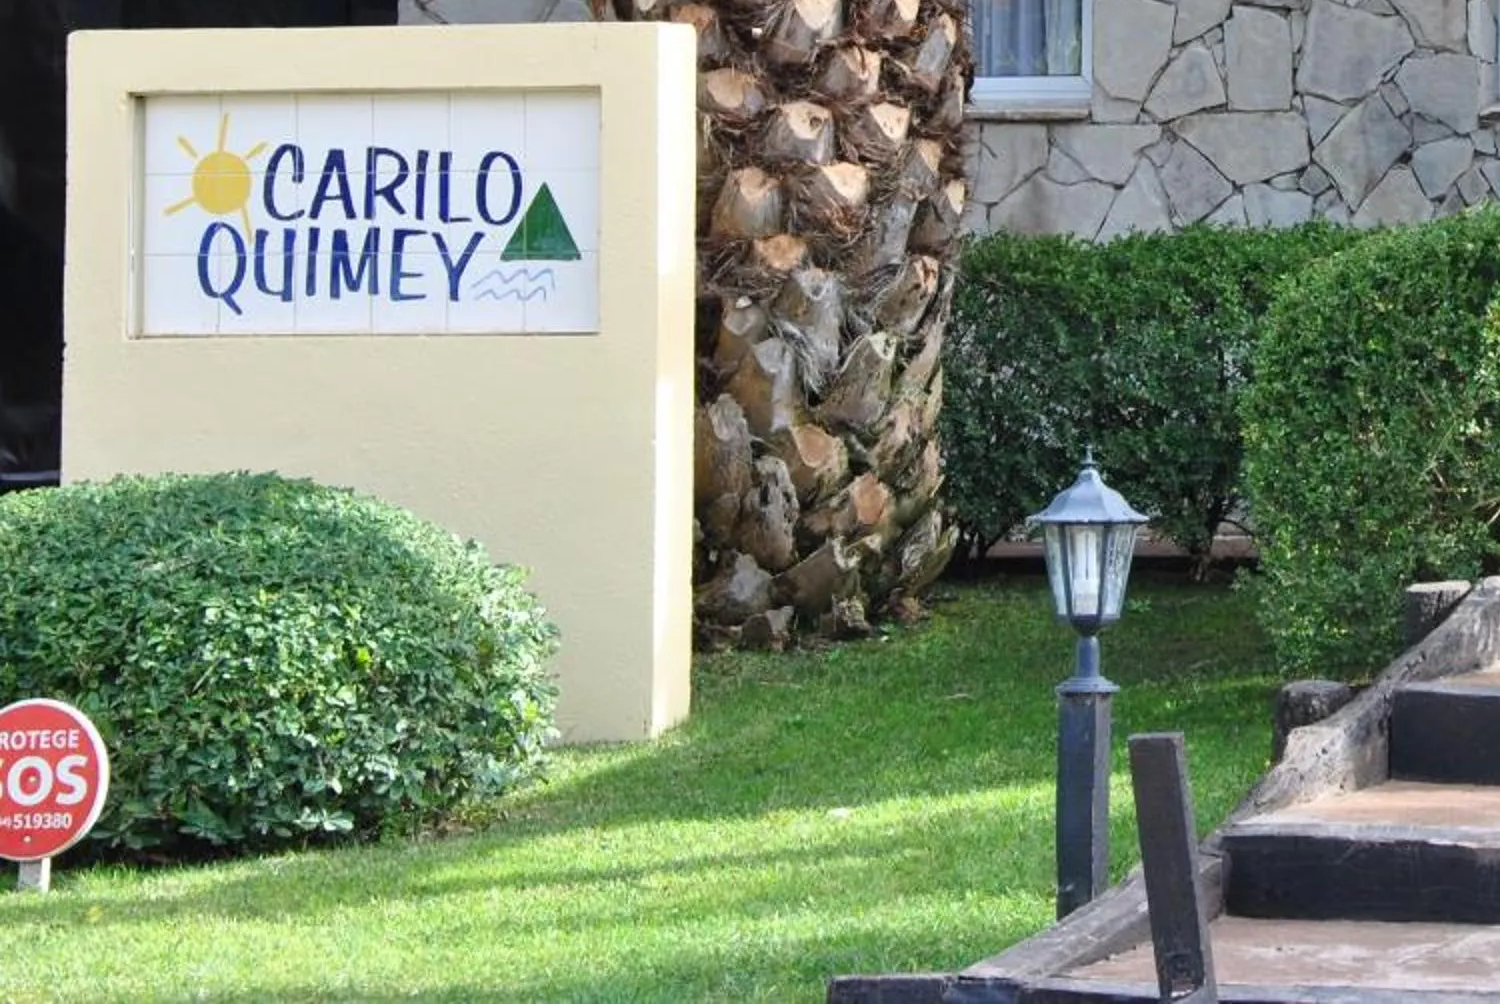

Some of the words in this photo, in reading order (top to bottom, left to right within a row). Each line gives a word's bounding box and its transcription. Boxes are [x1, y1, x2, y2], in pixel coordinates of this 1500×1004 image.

[262, 142, 523, 226] CARILO
[197, 222, 485, 315] QUIMEY
[0, 754, 88, 807] OS
